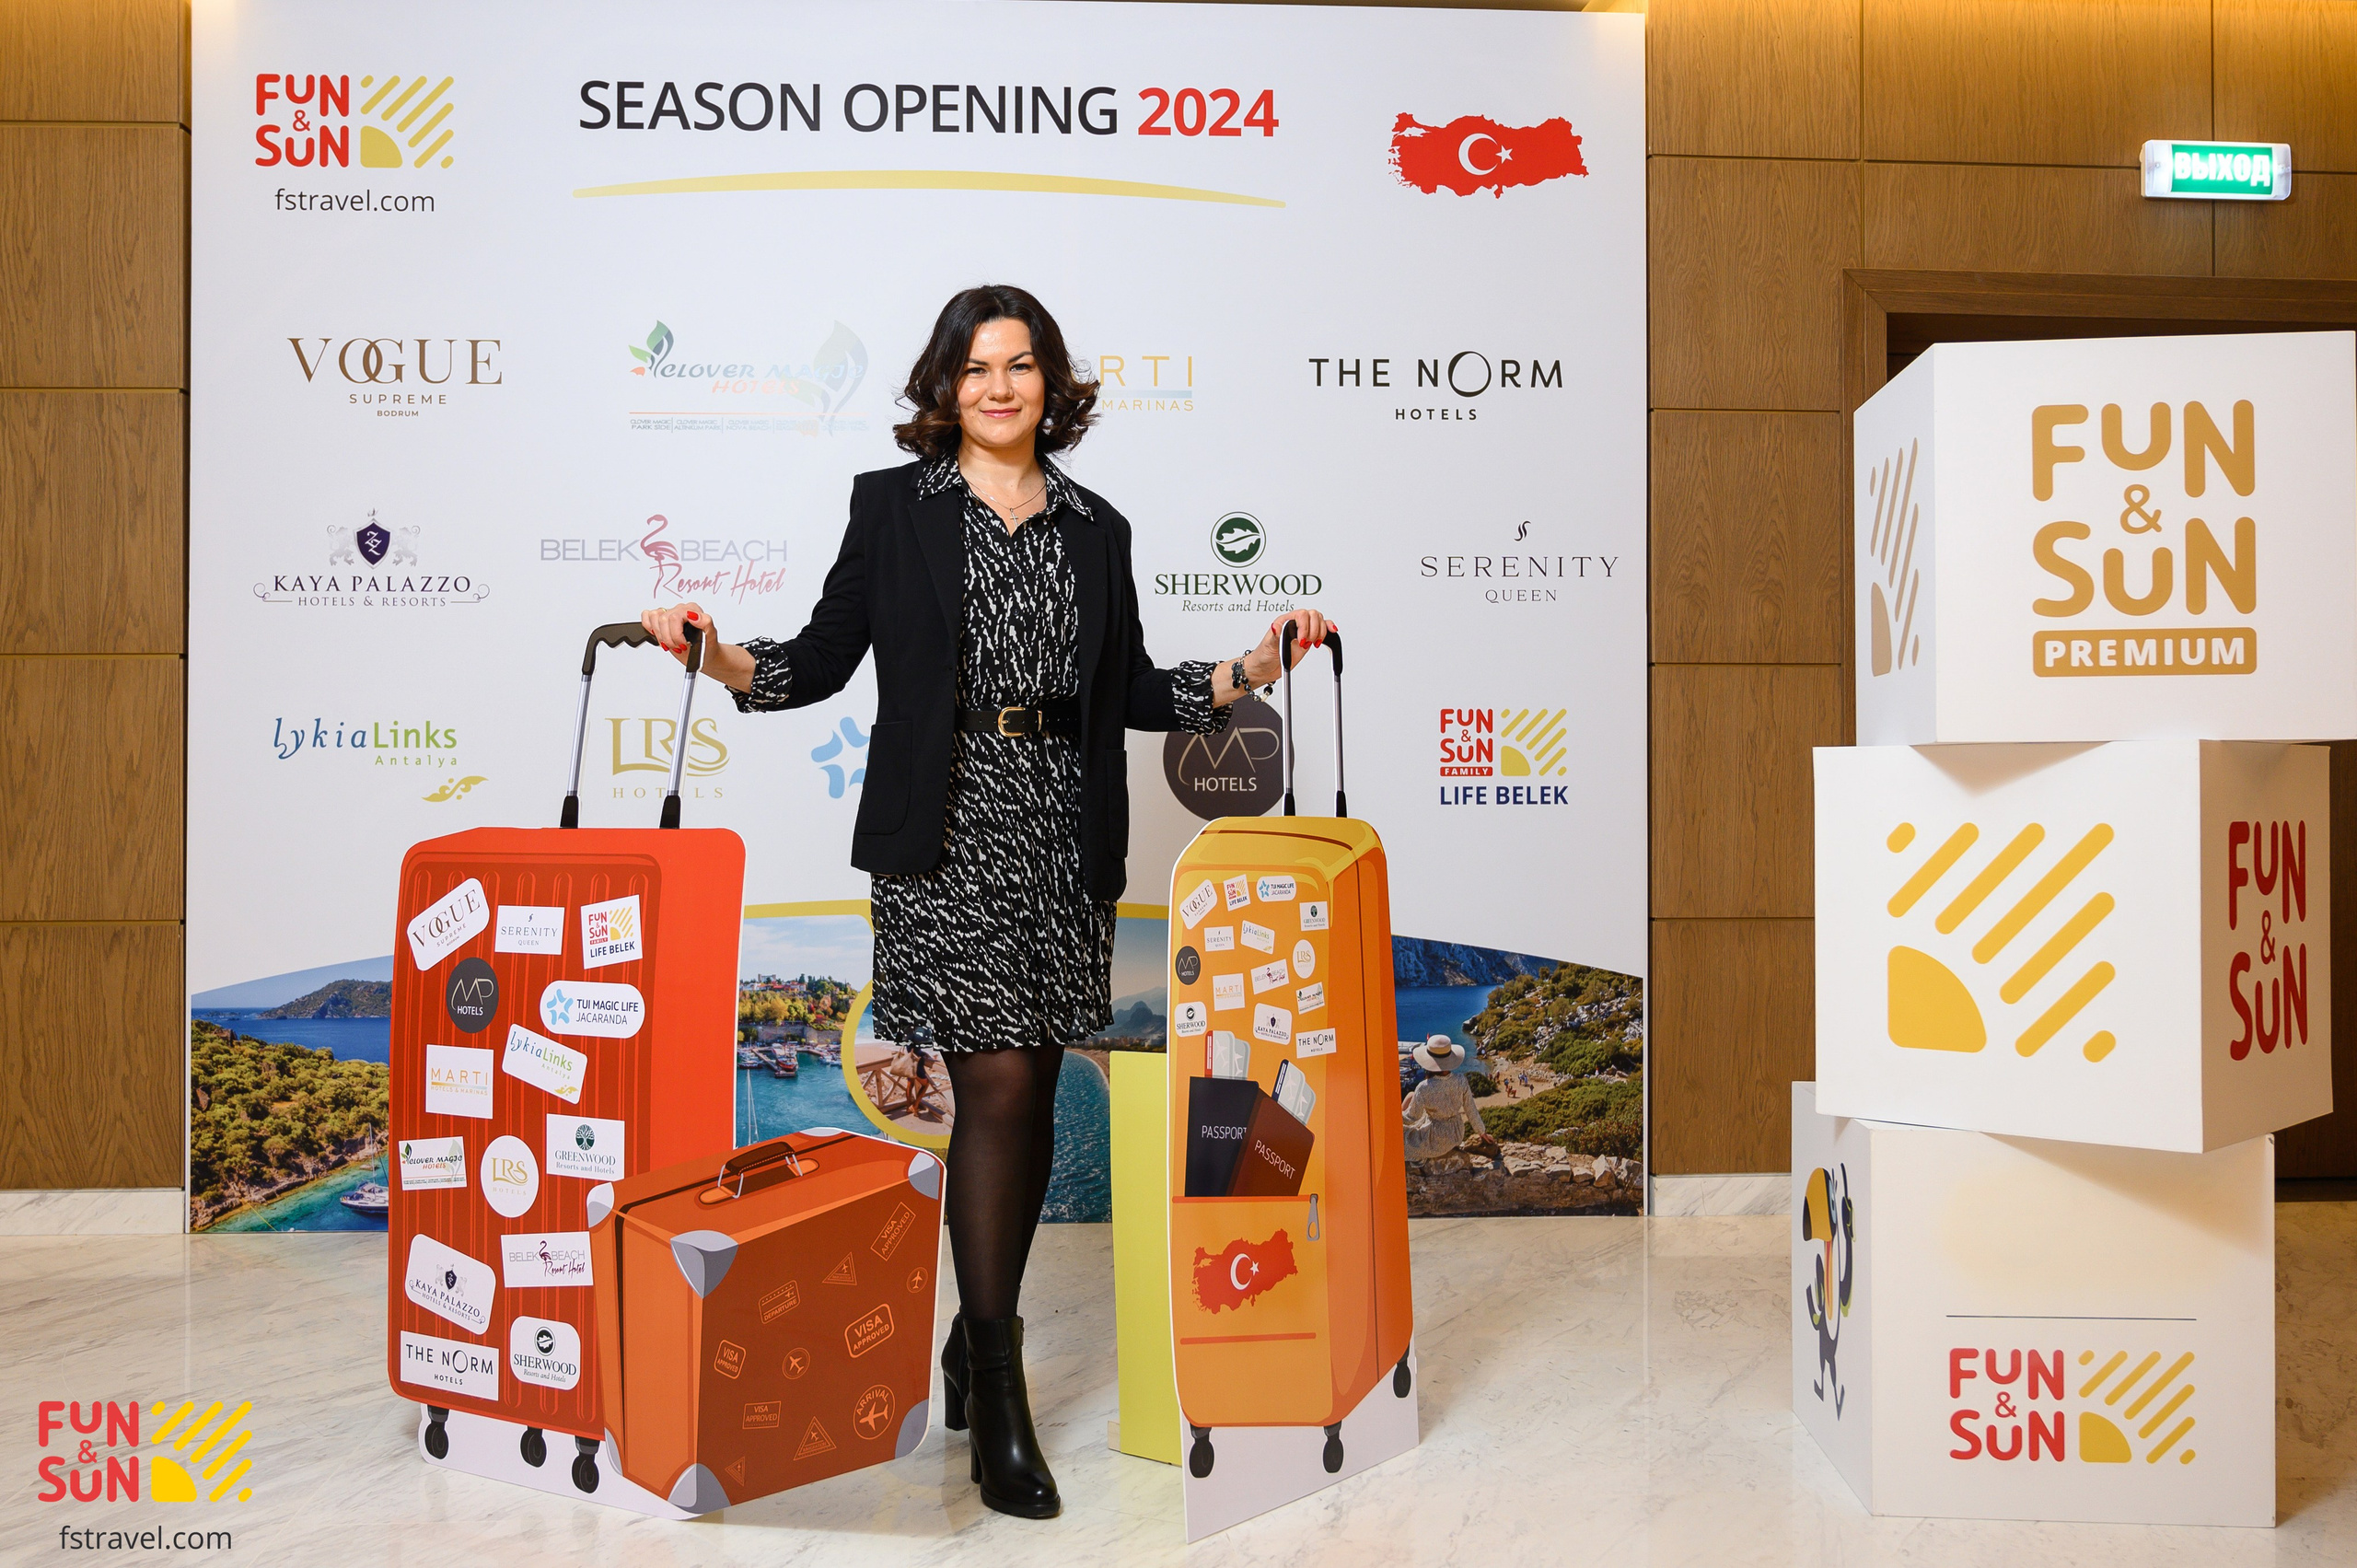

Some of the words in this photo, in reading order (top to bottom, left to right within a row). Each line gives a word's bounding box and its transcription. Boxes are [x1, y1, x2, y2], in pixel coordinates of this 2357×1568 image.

[255, 73, 350, 117] FUN
[579, 80, 822, 132] SEASON
[842, 83, 1119, 135] OPENING
[1137, 87, 1280, 138] 2024
[292, 109, 311, 133] &
[254, 123, 350, 168] SUN
[2174, 151, 2271, 187] ВЫХОД
[274, 188, 435, 213] fstravel.com
[285, 337, 504, 386] VOGUE
[660, 364, 755, 379] CLOVER
[1099, 354, 1193, 388] RTI
[1308, 358, 1390, 388] THE
[1417, 350, 1563, 398] NORM
[712, 379, 800, 395] HOTELS
[349, 393, 447, 405] SUPREME
[1101, 399, 1194, 412] MARINAS
[1395, 408, 1478, 421] HOTELS
[2031, 399, 2256, 503] FUN
[2119, 483, 2163, 535] &
[540, 539, 640, 562] BELEK
[680, 539, 788, 562] BEACH
[1421, 555, 1620, 578] SERENITY
[2032, 516, 2257, 618] SUN
[273, 575, 341, 593] KAYA
[351, 575, 471, 593] PALAZZO
[649, 562, 731, 599] Resort
[730, 559, 786, 605] Hotel
[1154, 574, 1322, 596] SHERWOOD
[298, 596, 355, 607] HOTELS
[363, 596, 375, 607] &
[381, 596, 447, 607] RESORTS
[1181, 599, 1224, 612] Resorts
[1227, 599, 1251, 612] and
[1256, 599, 1295, 612] Hotels
[1485, 589, 1557, 604] QUEEN
[2044, 636, 2246, 668] PREMIUM
[1440, 708, 1493, 734] FUN
[1460, 728, 1471, 743] &
[604, 717, 731, 777] LRS
[1439, 738, 1493, 763] SUN
[374, 754, 458, 768] Antalya
[612, 787, 724, 798] HOTLS
[1194, 776, 1258, 792] HOTELS
[1440, 786, 1487, 806] LIFE
[1495, 785, 1569, 806] BELEK
[2228, 819, 2306, 931] FUN
[1181, 884, 1213, 917] VOGUE
[412, 889, 481, 947] VOGUE
[588, 911, 608, 926] FUN
[436, 923, 467, 947] SUPREME
[500, 925, 559, 937] SERENITY
[589, 924, 608, 939] SUN
[1206, 935, 1232, 944] SERENITY
[2259, 910, 2276, 965] &
[590, 946, 608, 958] LIFE
[609, 940, 635, 955] BELEK
[1214, 984, 1243, 994] MARTI
[457, 1005, 483, 1016] HOTELS
[576, 999, 591, 1010] TUI
[592, 999, 619, 1012] MAGIC
[621, 1000, 639, 1013] LIFE
[2229, 942, 2308, 1062] SUN
[575, 1013, 628, 1026] JACARANDA
[1176, 1020, 1206, 1030] SHERWOOD
[1297, 1038, 1311, 1047] THE
[1313, 1033, 1334, 1046] NORM
[430, 1067, 488, 1086] MARTI
[540, 1063, 572, 1080] Antalya
[430, 1086, 454, 1094] HOTELS
[460, 1087, 489, 1096] MARINAS
[554, 1150, 616, 1167] GREENWOOD
[555, 1161, 580, 1172] Resorts
[580, 1164, 593, 1173] and
[594, 1164, 615, 1175] Hotels
[1254, 1139, 1296, 1180] PASSPORT
[491, 1157, 529, 1187] LRS
[493, 1187, 527, 1196] HOTELS
[880, 1210, 911, 1256] APPROVED
[881, 1219, 898, 1240] VISA
[508, 1250, 540, 1262] BELEK
[551, 1249, 586, 1261] BEACH
[415, 1278, 437, 1298] KAYA
[439, 1290, 481, 1318] PALAZZO
[422, 1292, 441, 1307] HOTELS
[447, 1305, 470, 1321] RESORTS
[763, 1297, 798, 1321] DEPARTURE
[853, 1314, 884, 1338] VISA
[853, 1323, 890, 1352] APPROVED
[405, 1343, 434, 1364] THE
[441, 1349, 493, 1376] NORM
[513, 1353, 577, 1376] SHERWOOD
[716, 1357, 738, 1374] APPROVED
[722, 1346, 739, 1364] VISA
[434, 1373, 463, 1386] HOTELS
[540, 1371, 551, 1380] and
[1949, 1347, 2065, 1401] FUN
[753, 1405, 769, 1413] VISA
[855, 1388, 890, 1416] ARRIVAL
[1995, 1391, 2017, 1419] &
[745, 1413, 778, 1423] APPROVED
[1949, 1409, 2065, 1462] SUN
